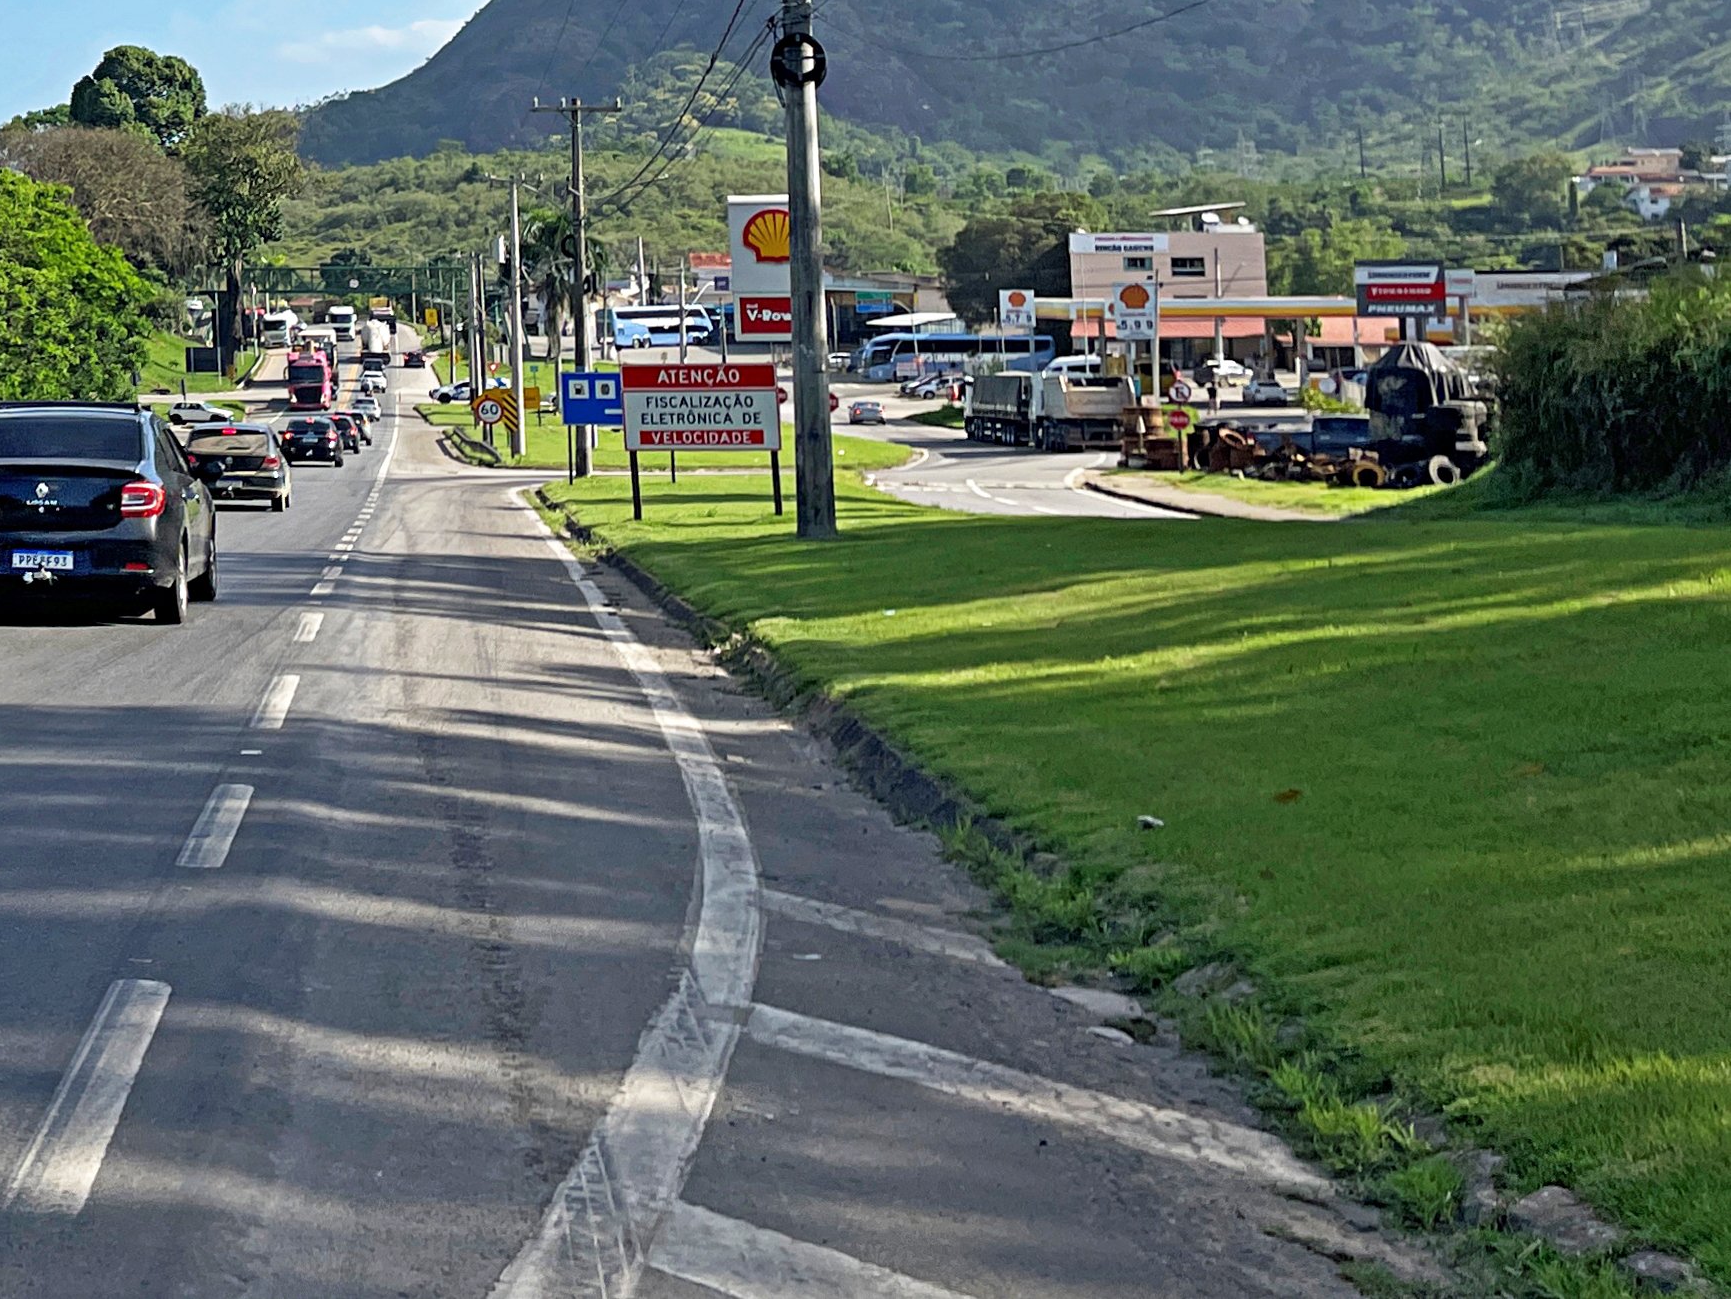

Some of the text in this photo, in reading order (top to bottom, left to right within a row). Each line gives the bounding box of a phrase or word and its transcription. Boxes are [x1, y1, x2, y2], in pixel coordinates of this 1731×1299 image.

[657, 367, 741, 386] ATENÇÃO
[480, 403, 499, 416] 60
[645, 393, 755, 410] FISCALIZAÇÃO
[641, 409, 763, 425] ELETRÔNICA DE
[651, 431, 753, 444] VELOCIDADE
